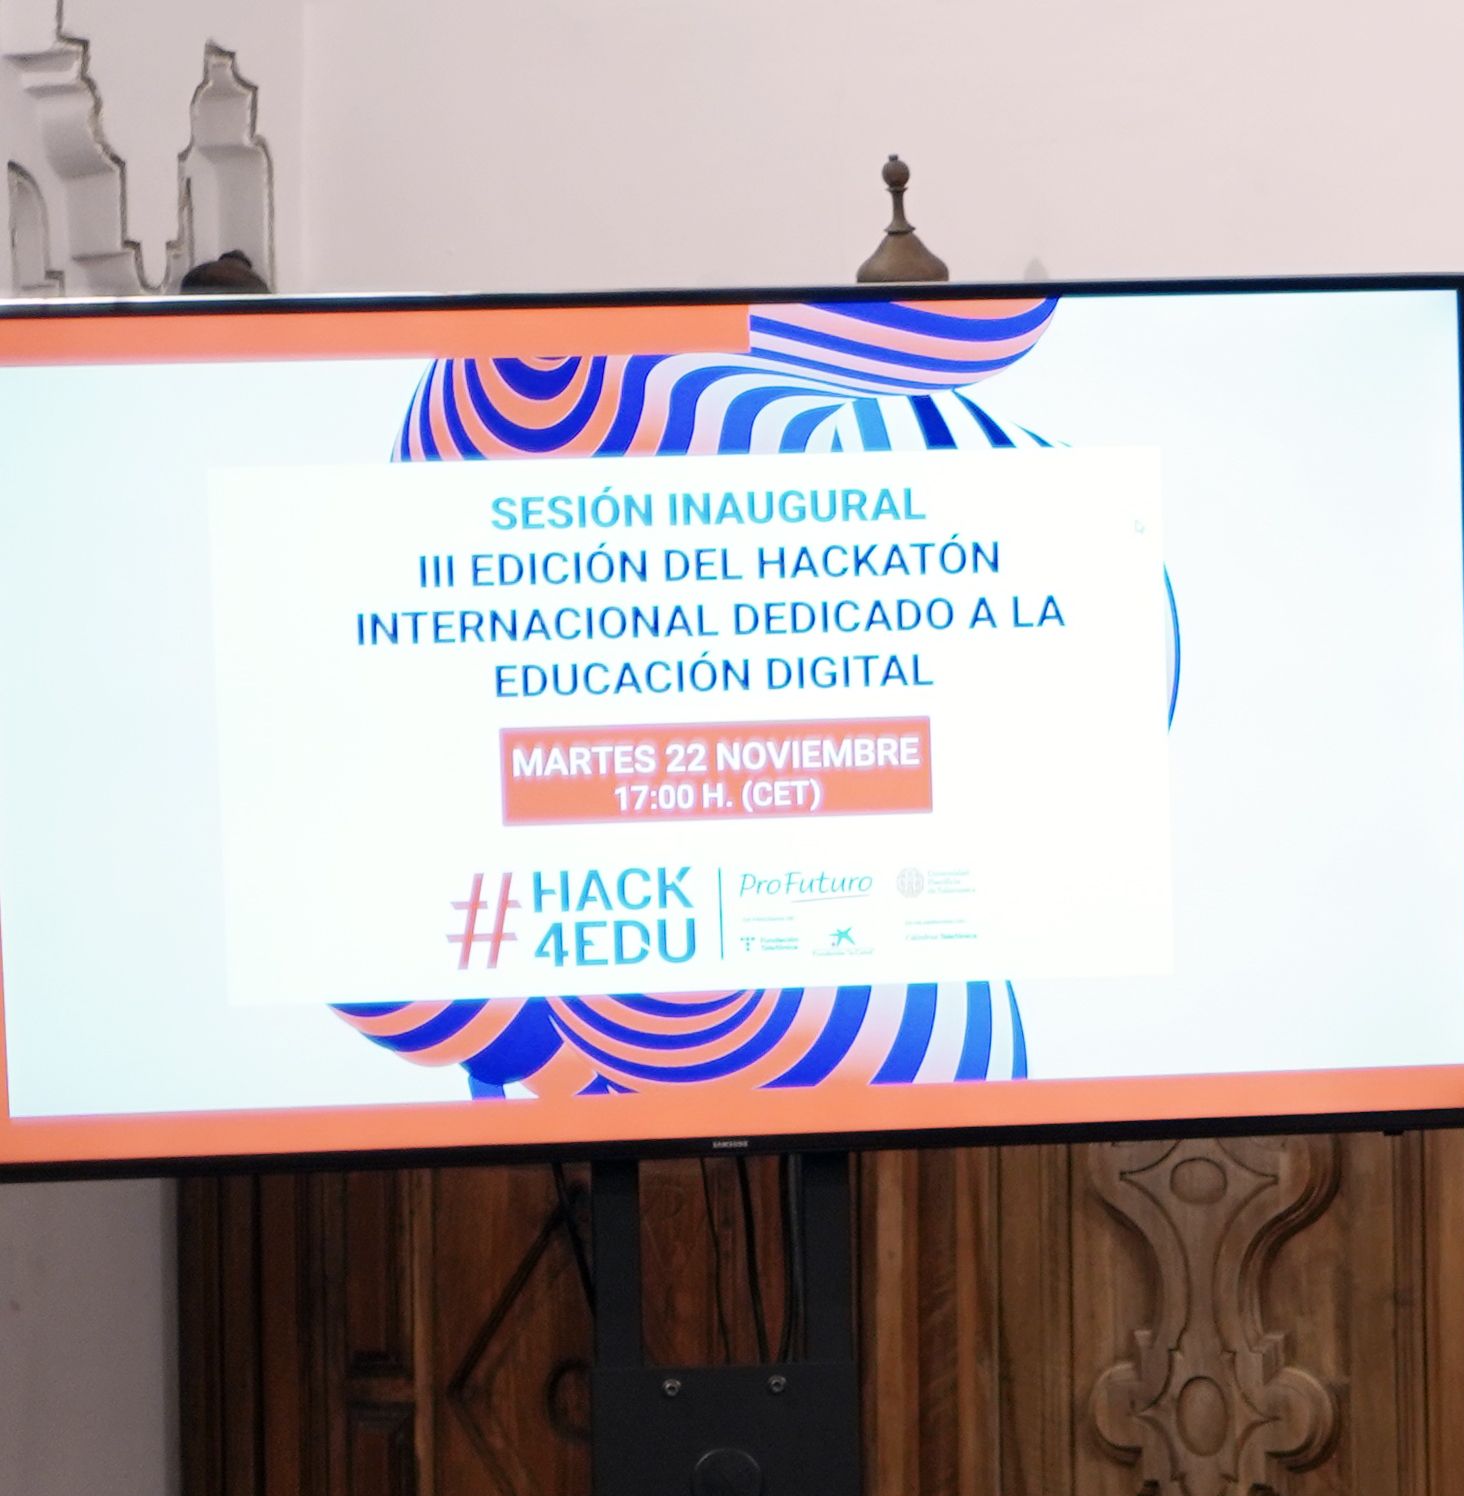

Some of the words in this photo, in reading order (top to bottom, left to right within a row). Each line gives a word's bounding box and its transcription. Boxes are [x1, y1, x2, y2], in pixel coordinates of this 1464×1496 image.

[490, 485, 653, 531] SESIÓN
[667, 487, 927, 526] INAUGURAL
[418, 554, 455, 588] III
[471, 541, 647, 588] EDICIÓN
[663, 547, 743, 582] DEL
[757, 533, 1000, 580] HACKATÓN
[356, 603, 719, 646] INTERNACIONAL
[733, 596, 954, 636] DEDICADO
[968, 596, 997, 629] A
[1012, 594, 1066, 628] LA
[495, 650, 751, 698] EDUCACIÓN
[767, 653, 934, 690] DIGITAL
[511, 743, 656, 778] MARTES
[664, 743, 707, 773] 22
[716, 736, 920, 771] NOVIEMBRE
[613, 783, 694, 812] 17:00
[702, 783, 733, 809] H.
[742, 777, 822, 813] (CET)
[533, 866, 694, 913] HACK
[739, 870, 873, 897] ProFuturo
[534, 917, 697, 967] 4EDU
